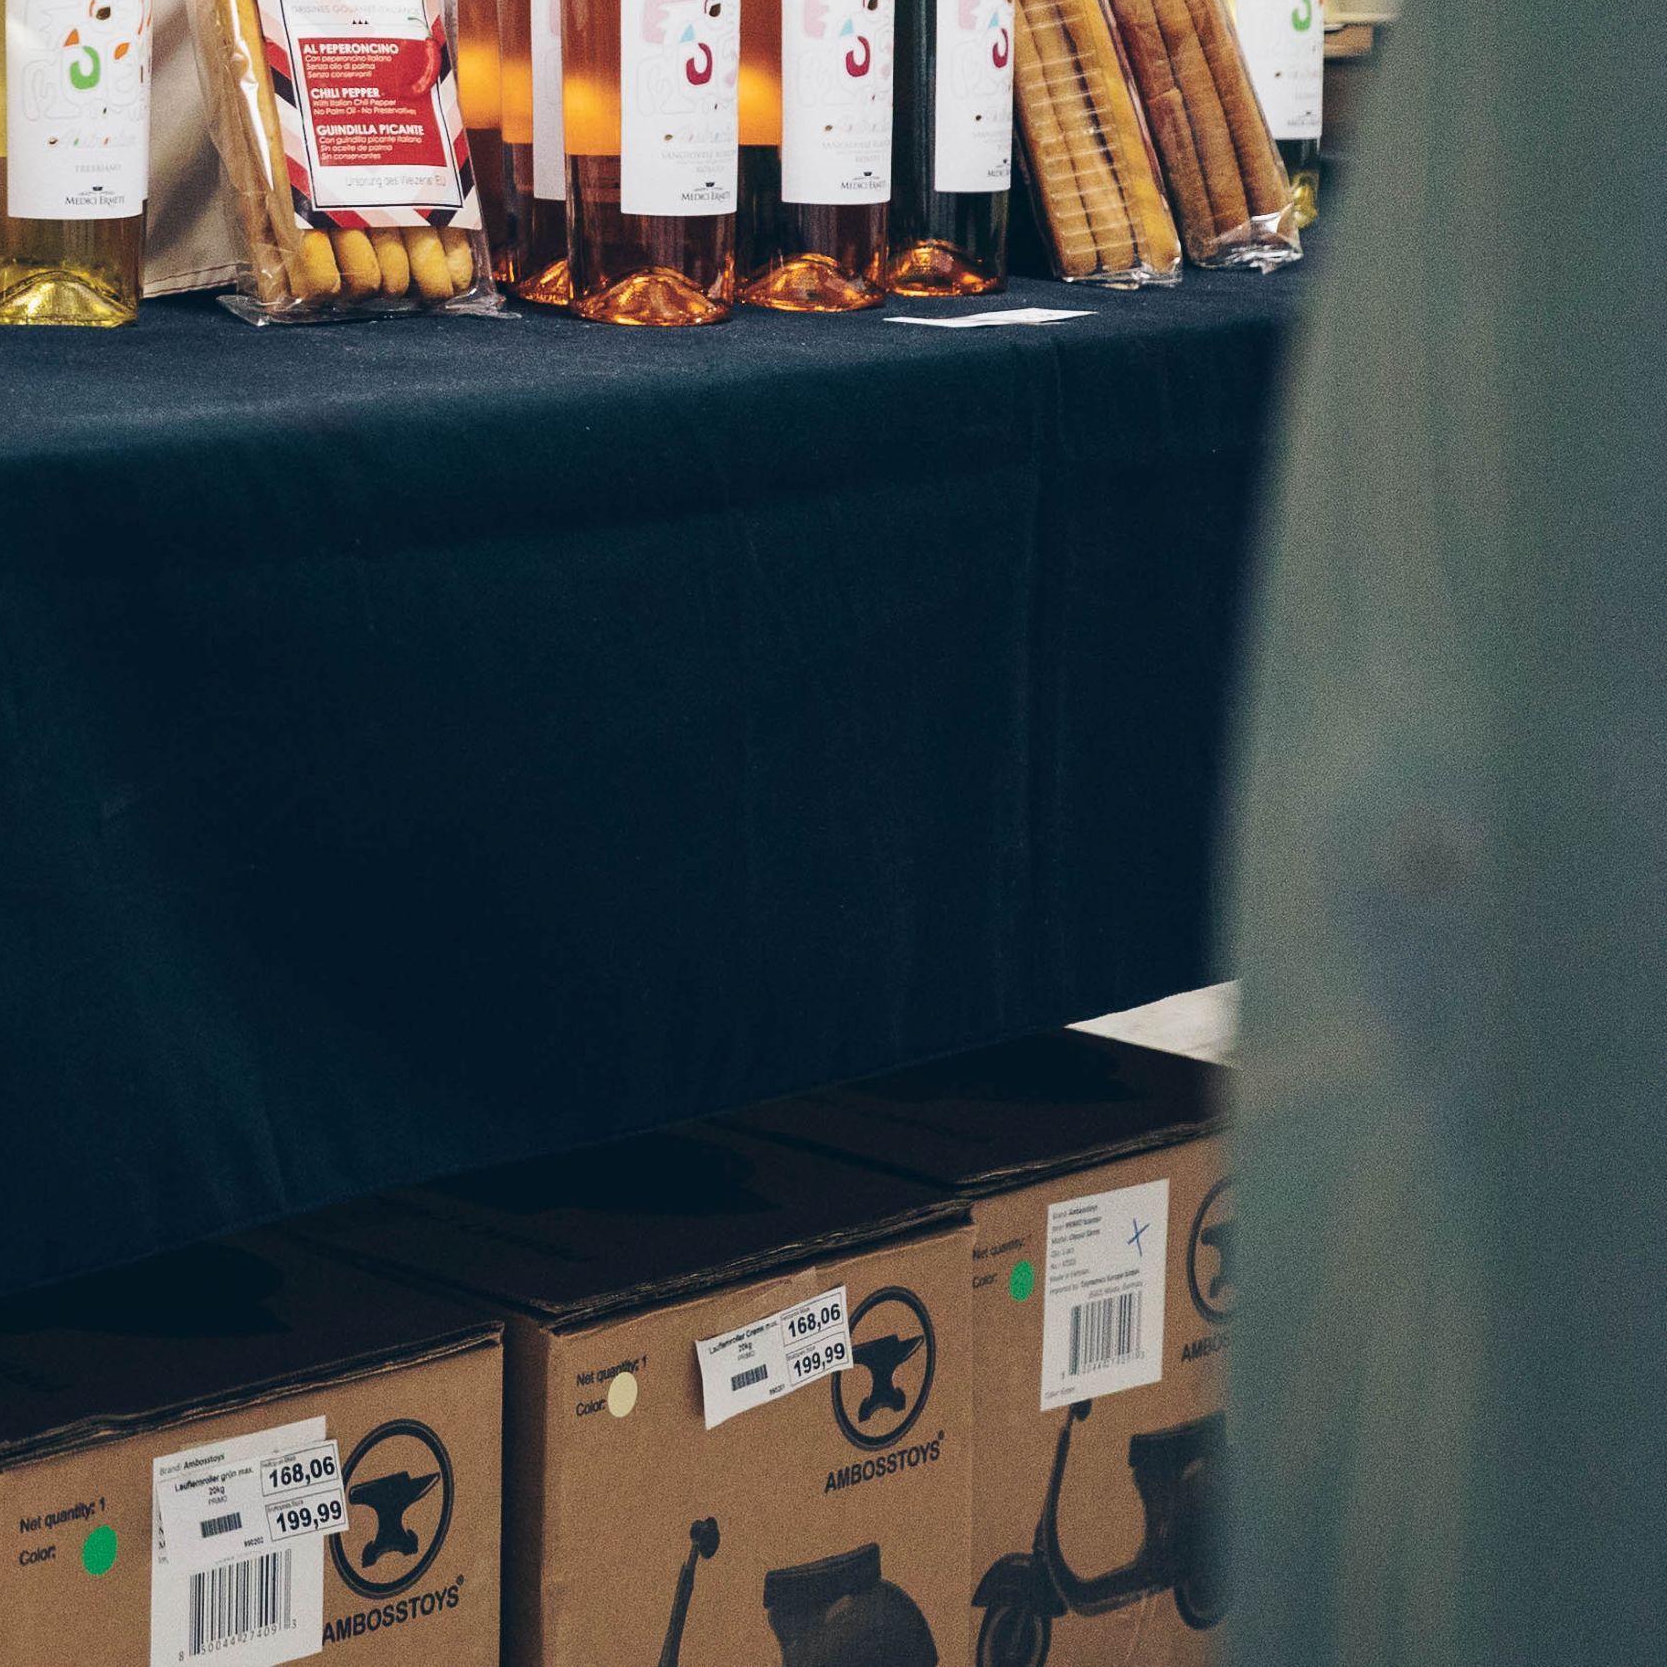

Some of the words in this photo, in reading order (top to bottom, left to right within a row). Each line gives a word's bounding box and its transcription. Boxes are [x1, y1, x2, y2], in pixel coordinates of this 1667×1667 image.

[303, 43, 318, 54] AL
[319, 43, 399, 54] PEPERONCINO
[321, 55, 367, 64] peperoncino
[310, 88, 340, 99] CHILI
[341, 88, 380, 98] PEPPER
[317, 125, 377, 136] GUINDILLA
[378, 125, 425, 136] PICANTE
[64, 195, 95, 207] MEDICI
[788, 1303, 841, 1338] 168,06
[793, 1342, 846, 1377] 199,99
[575, 1372, 595, 1387] Net
[595, 1358, 640, 1381] quantity:
[575, 1398, 607, 1417] Color:
[159, 1463, 182, 1477] Brand:
[183, 1453, 226, 1470] Ambosstoys
[269, 1455, 336, 1489] 168,06
[208, 1485, 225, 1496] 20kg
[19, 1514, 42, 1533] Net
[43, 1501, 97, 1529] quantity:
[98, 1496, 106, 1511] 1
[275, 1499, 343, 1533] 199,99
[18, 1544, 57, 1567] Color:
